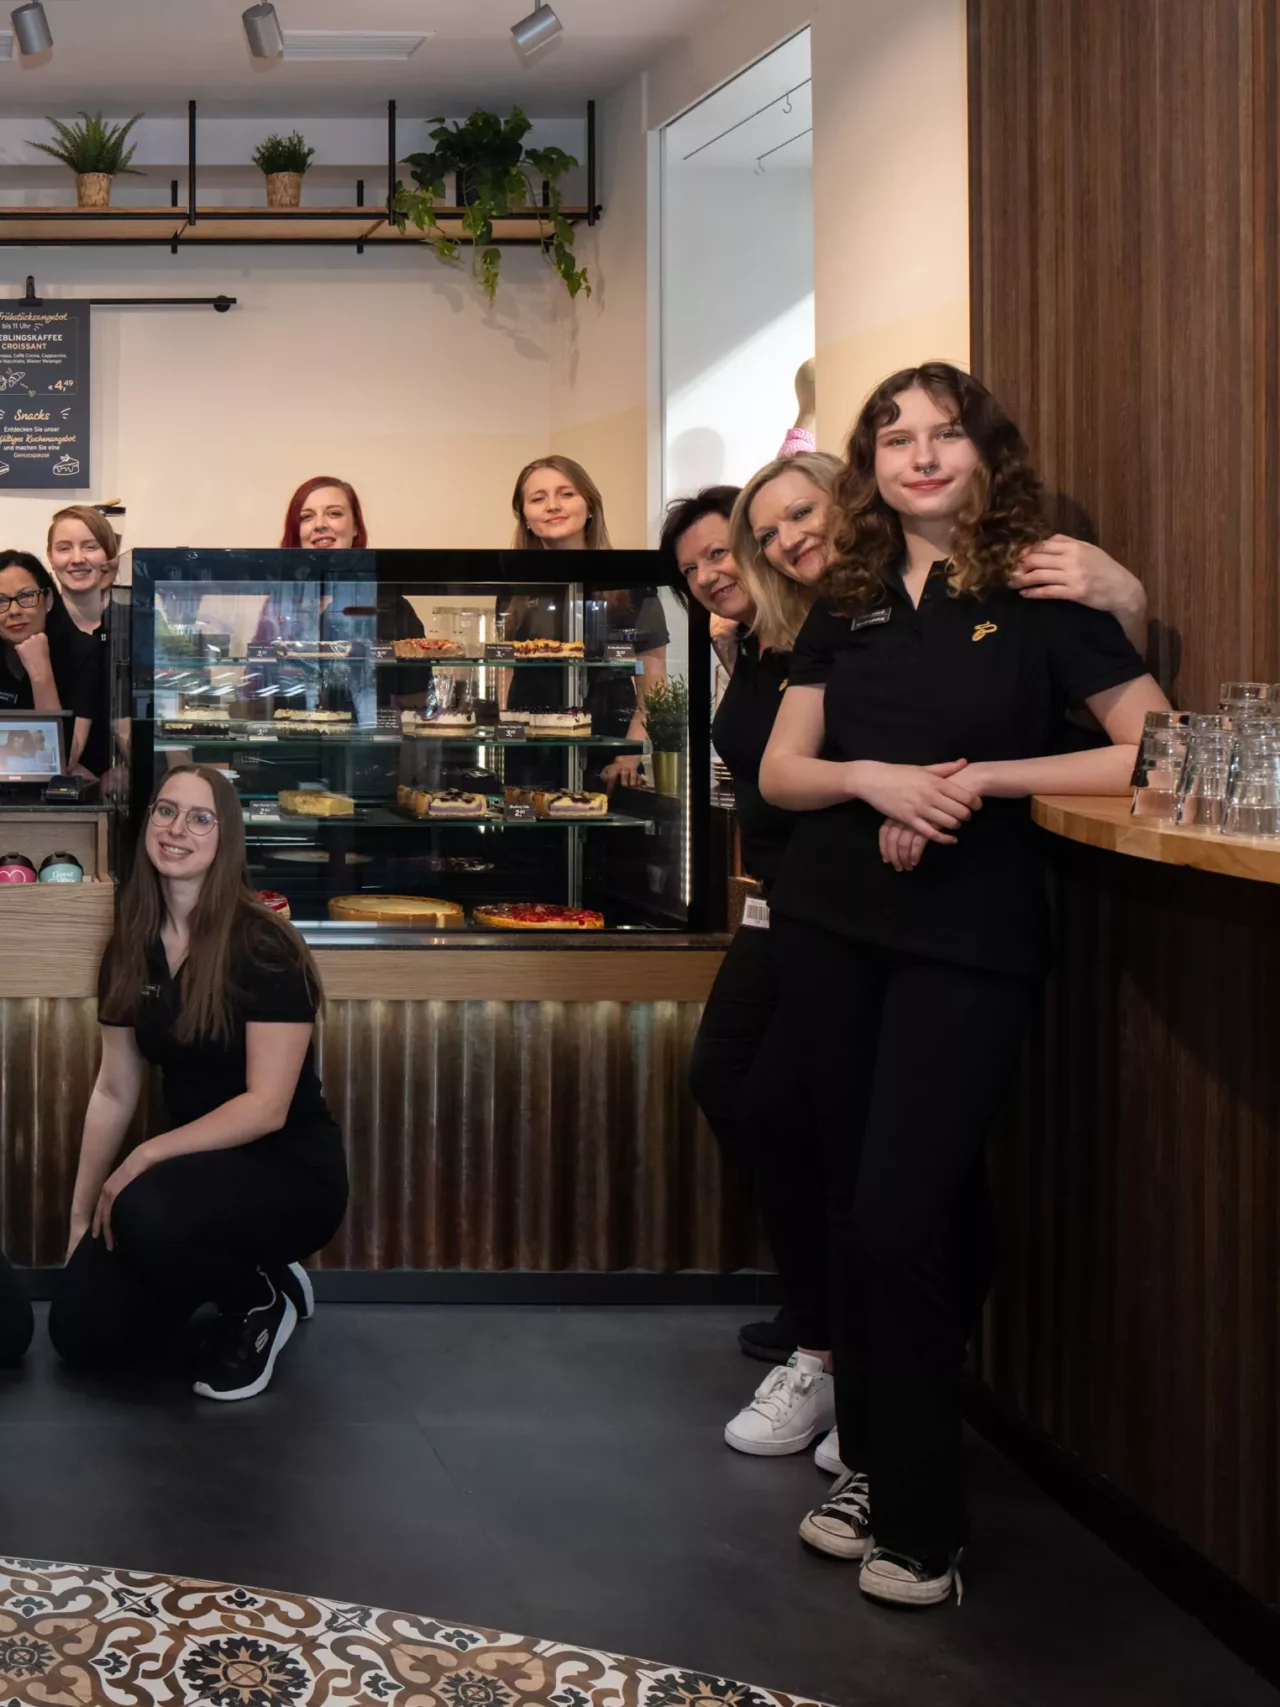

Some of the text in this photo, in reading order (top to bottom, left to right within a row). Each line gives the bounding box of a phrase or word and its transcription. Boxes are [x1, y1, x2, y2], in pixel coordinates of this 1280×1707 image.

[55, 380, 73, 392] 4,49
[14, 409, 50, 420] Snacks
[26, 434, 76, 444] Kuchenangebot
